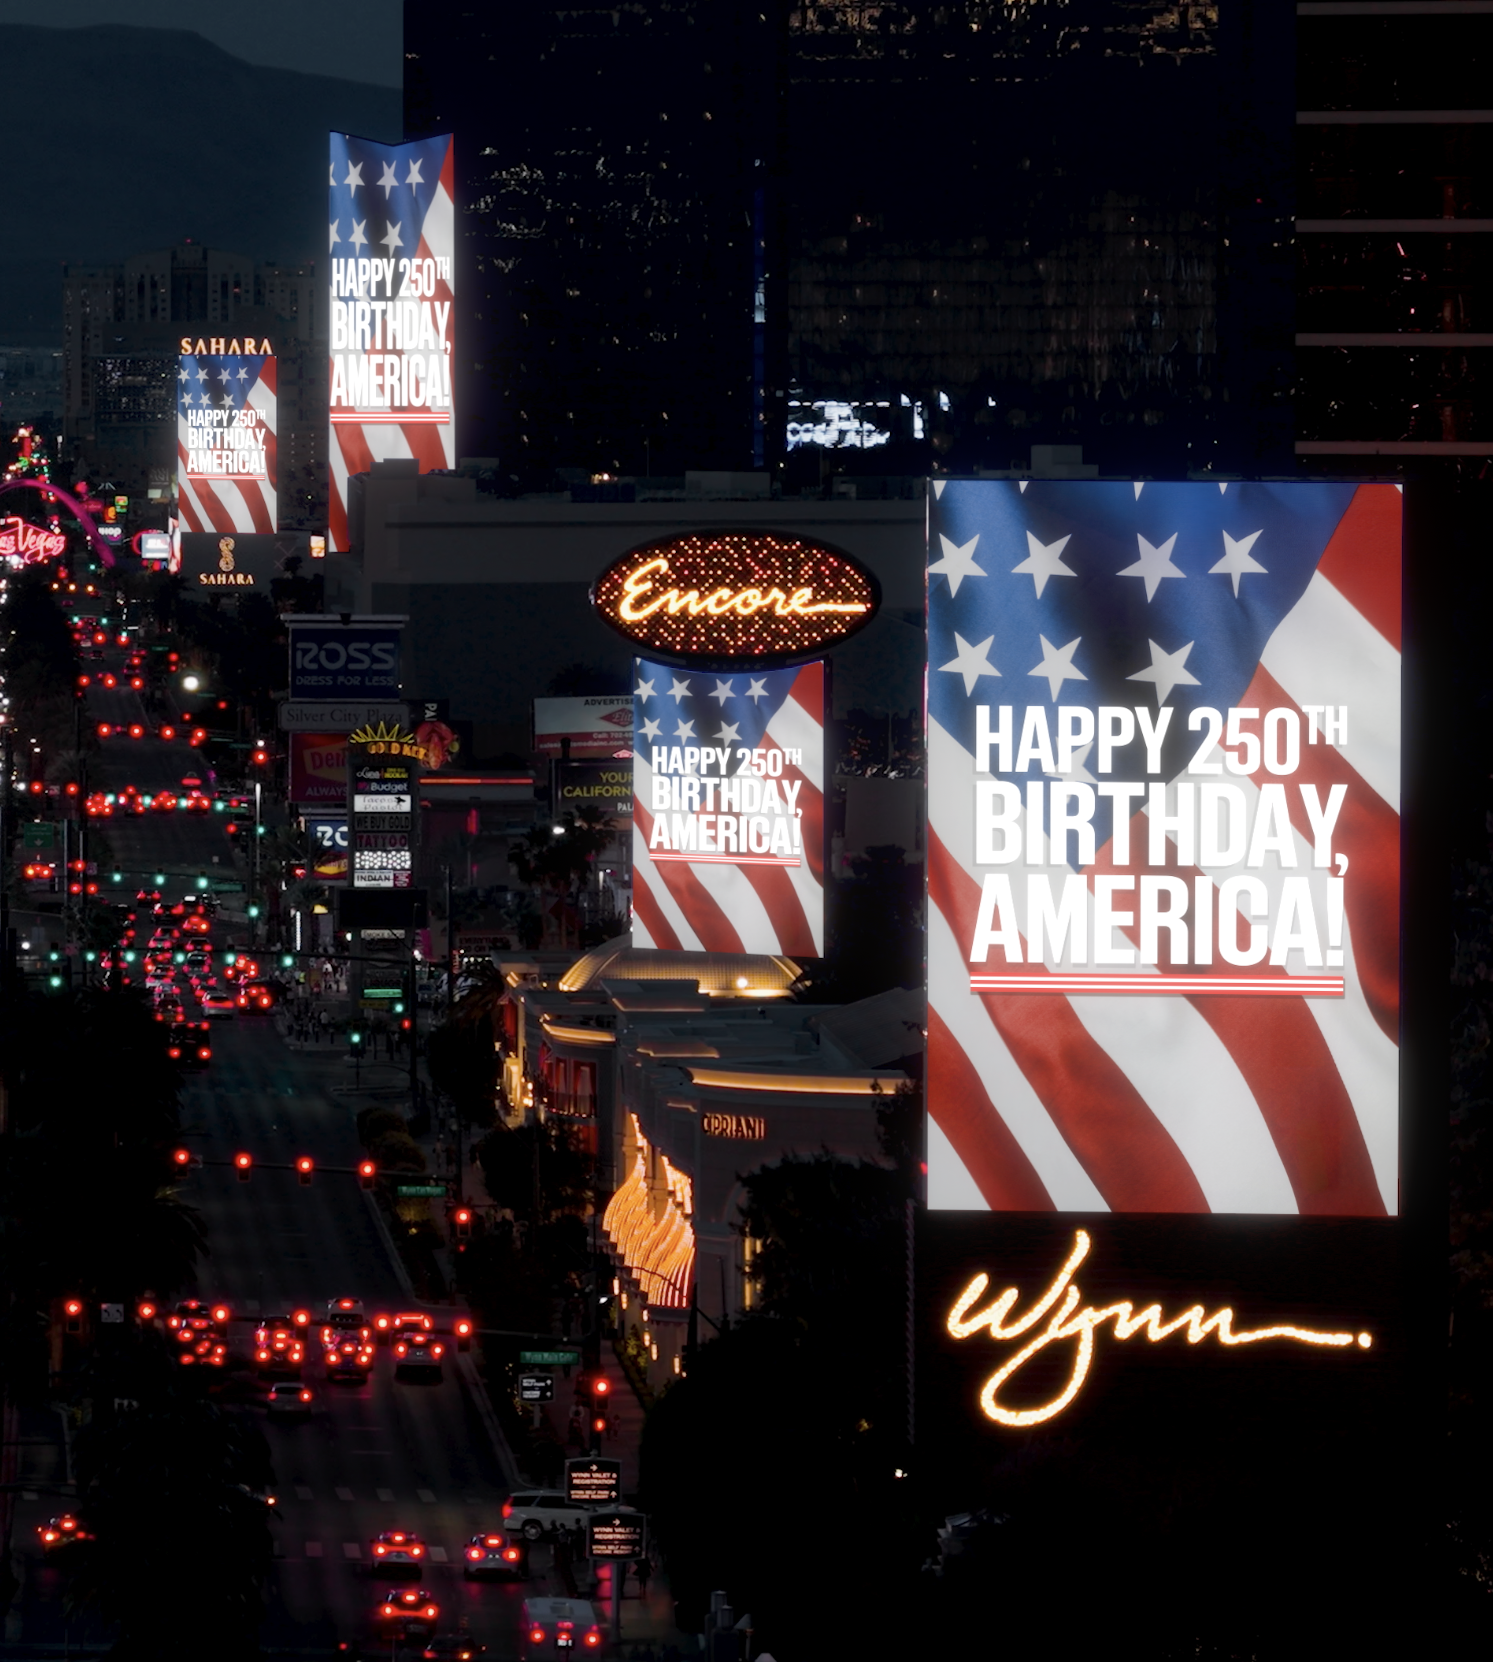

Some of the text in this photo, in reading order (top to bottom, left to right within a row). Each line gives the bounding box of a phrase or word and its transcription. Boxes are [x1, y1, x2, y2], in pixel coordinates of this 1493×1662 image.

[332, 258, 395, 297] HAPPY
[332, 301, 451, 354] BIRTHDAY,
[180, 337, 273, 355] SAHARA
[330, 354, 450, 407] AMERICA!
[187, 410, 229, 427] HAPPY
[188, 428, 266, 451] BIRTHDAY,
[187, 450, 265, 473] AMERICA!
[7, 515, 66, 565] Vegas
[199, 573, 254, 585] SAHARA
[619, 558, 867, 621] Encore
[295, 642, 395, 670] ROSS
[295, 676, 395, 686] DRESS FOR LESS
[286, 708, 403, 726] Silver City Plaza
[976, 705, 1349, 775] HAPPY 250TH
[652, 746, 731, 775] HAPPY
[370, 781, 409, 793] Budget
[651, 776, 803, 818] BIRTHDAY,
[356, 815, 410, 829] WE BUY GOLD
[649, 811, 802, 856] AMERICA!
[975, 780, 1349, 876] BIRTHDAY,
[357, 834, 408, 848] TATTOO
[969, 873, 1345, 967] AMERICA!
[703, 1112, 765, 1140] CIPRIANI
